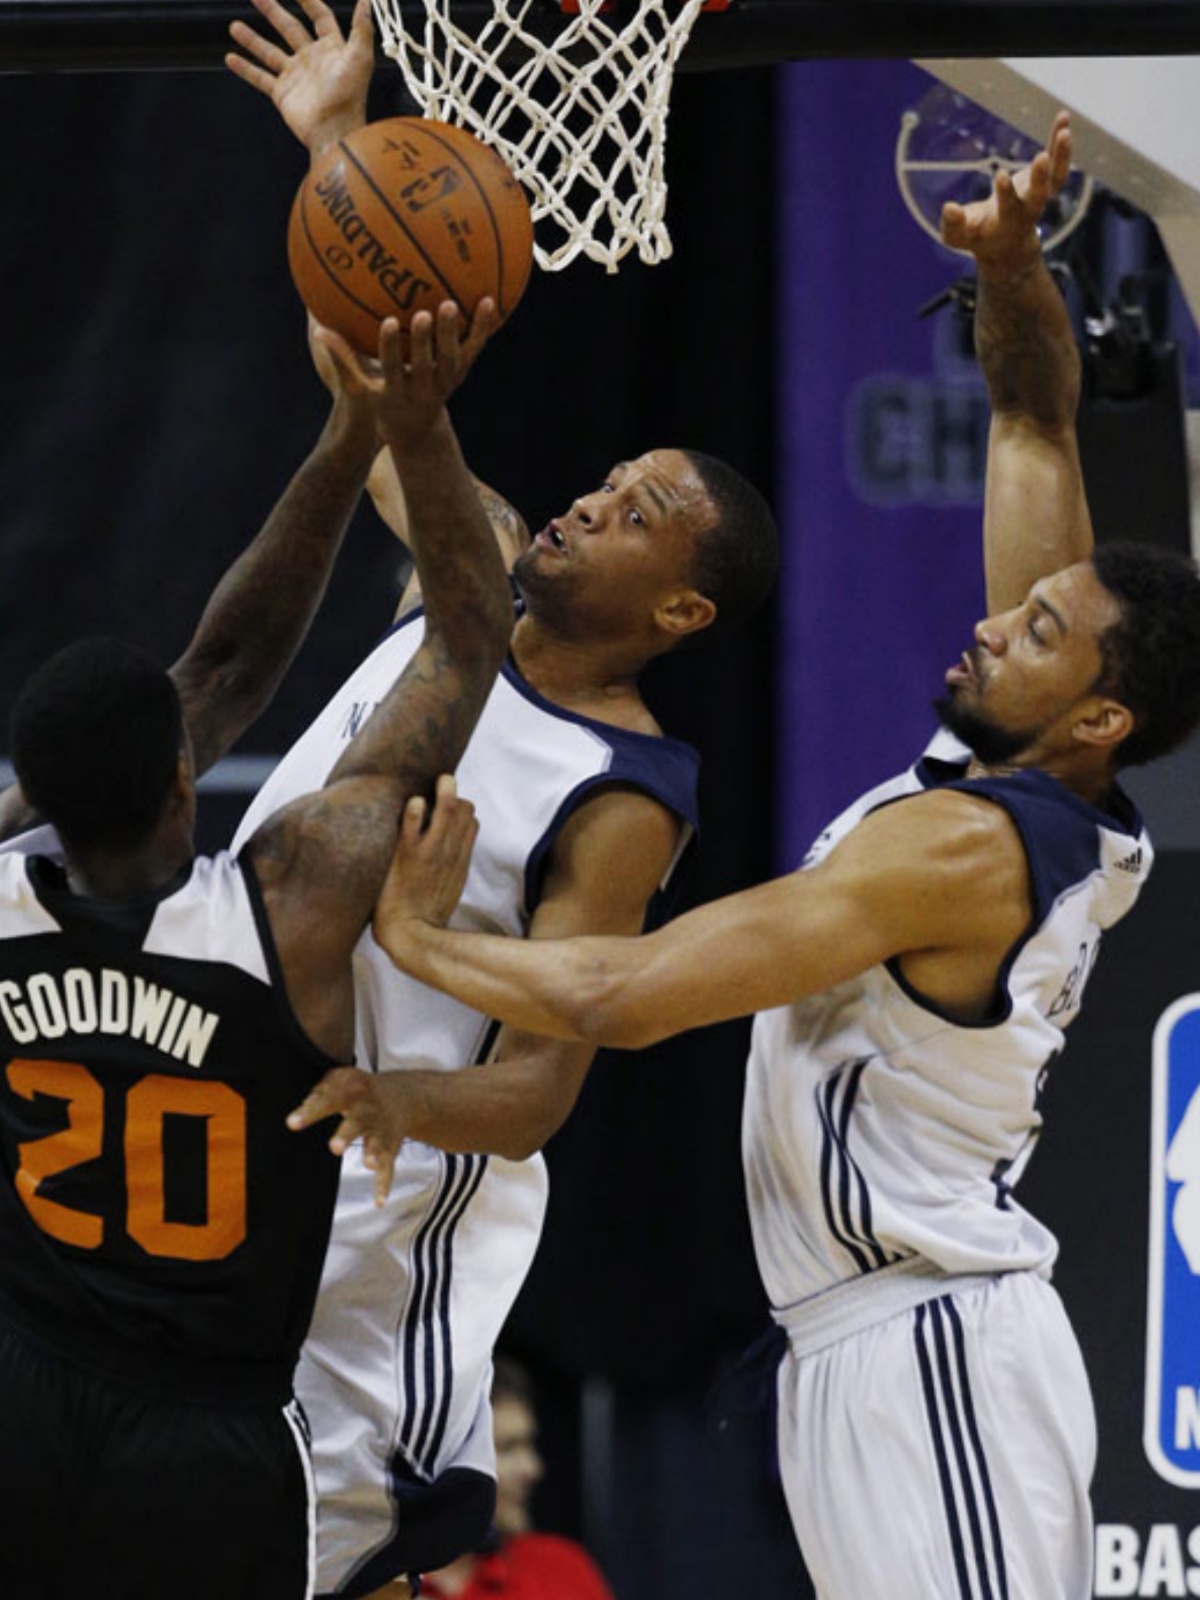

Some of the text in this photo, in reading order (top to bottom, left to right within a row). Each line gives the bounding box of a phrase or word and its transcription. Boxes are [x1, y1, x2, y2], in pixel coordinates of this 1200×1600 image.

[315, 161, 432, 311] SPALDING
[0, 967, 219, 1068] GOODWIN
[5, 1058, 247, 1261] 20
